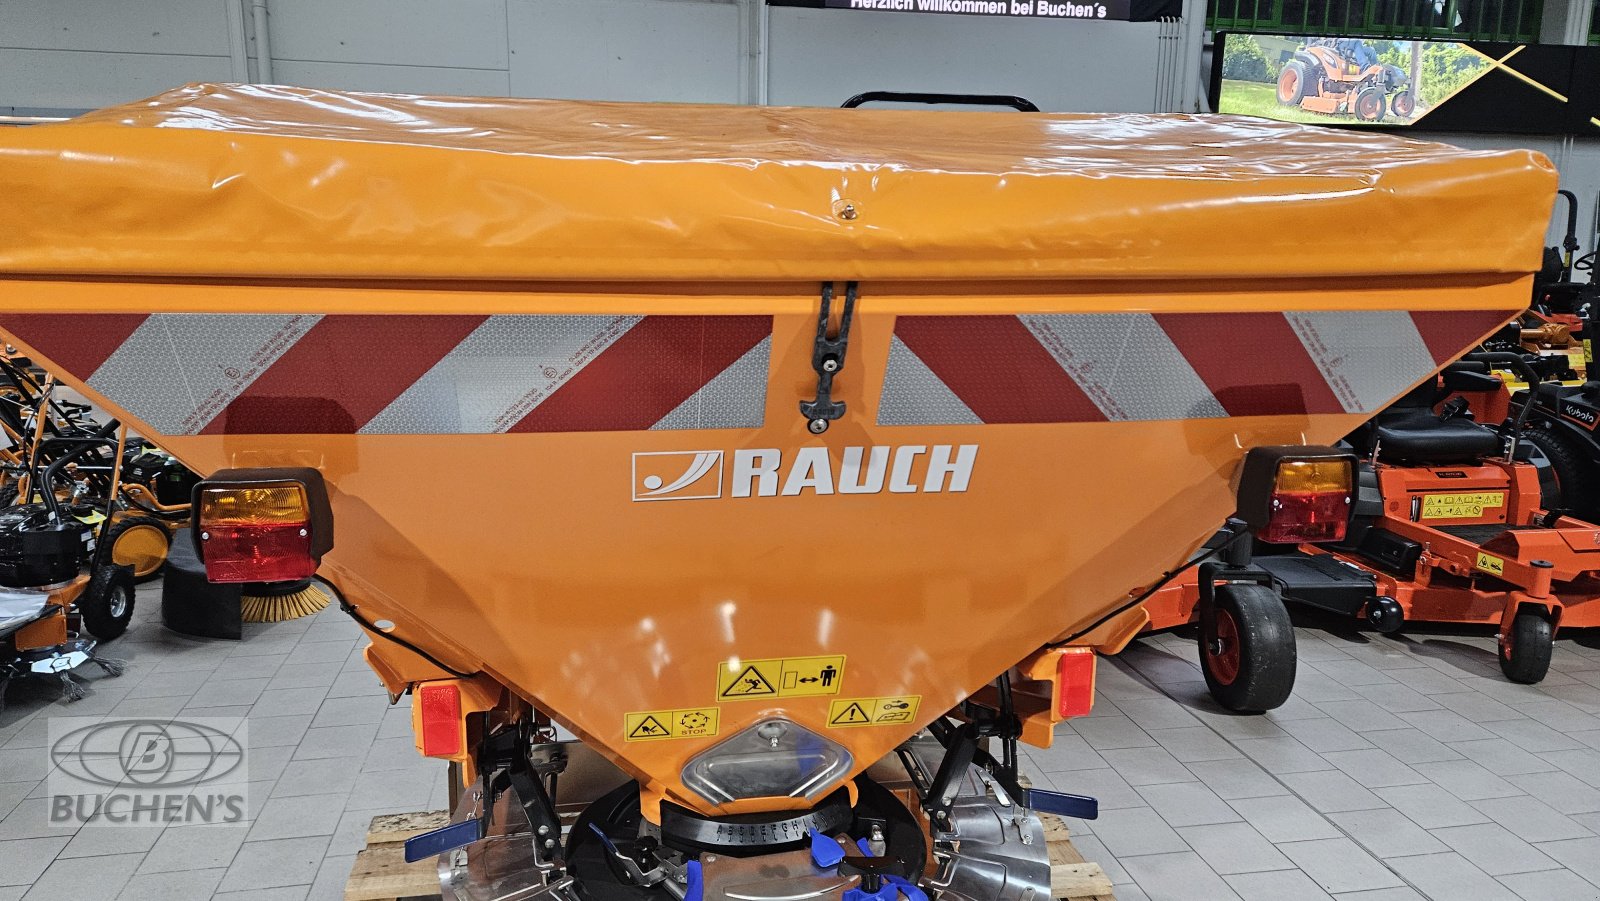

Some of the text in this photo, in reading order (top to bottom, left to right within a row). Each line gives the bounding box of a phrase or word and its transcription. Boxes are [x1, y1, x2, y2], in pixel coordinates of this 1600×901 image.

[850, 0, 914, 9] Herzlich
[916, 0, 1007, 13] willkommen
[1010, 0, 1034, 15] bei
[1566, 405, 1594, 422] Kubota
[731, 444, 979, 498] RAUCH
[681, 728, 706, 736] STOP
